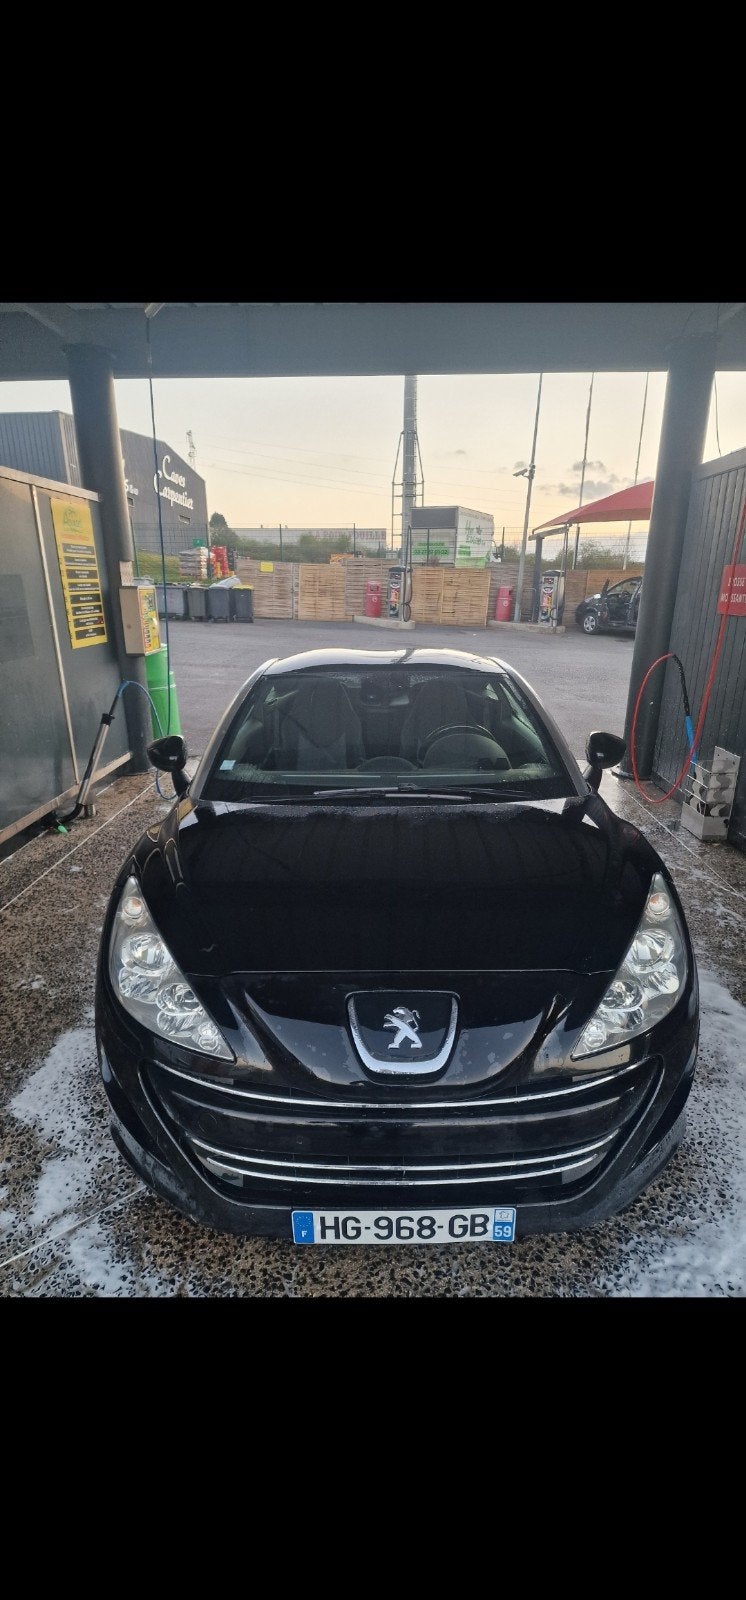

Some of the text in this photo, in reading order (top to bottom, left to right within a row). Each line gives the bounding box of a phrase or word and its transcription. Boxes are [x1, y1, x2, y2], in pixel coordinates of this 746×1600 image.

[163, 455, 186, 488] Caves
[153, 469, 194, 510] Carpentier
[301, 1230, 307, 1238] F
[319, 1213, 490, 1240] HG-968-GB
[494, 1225, 512, 1238] 59
